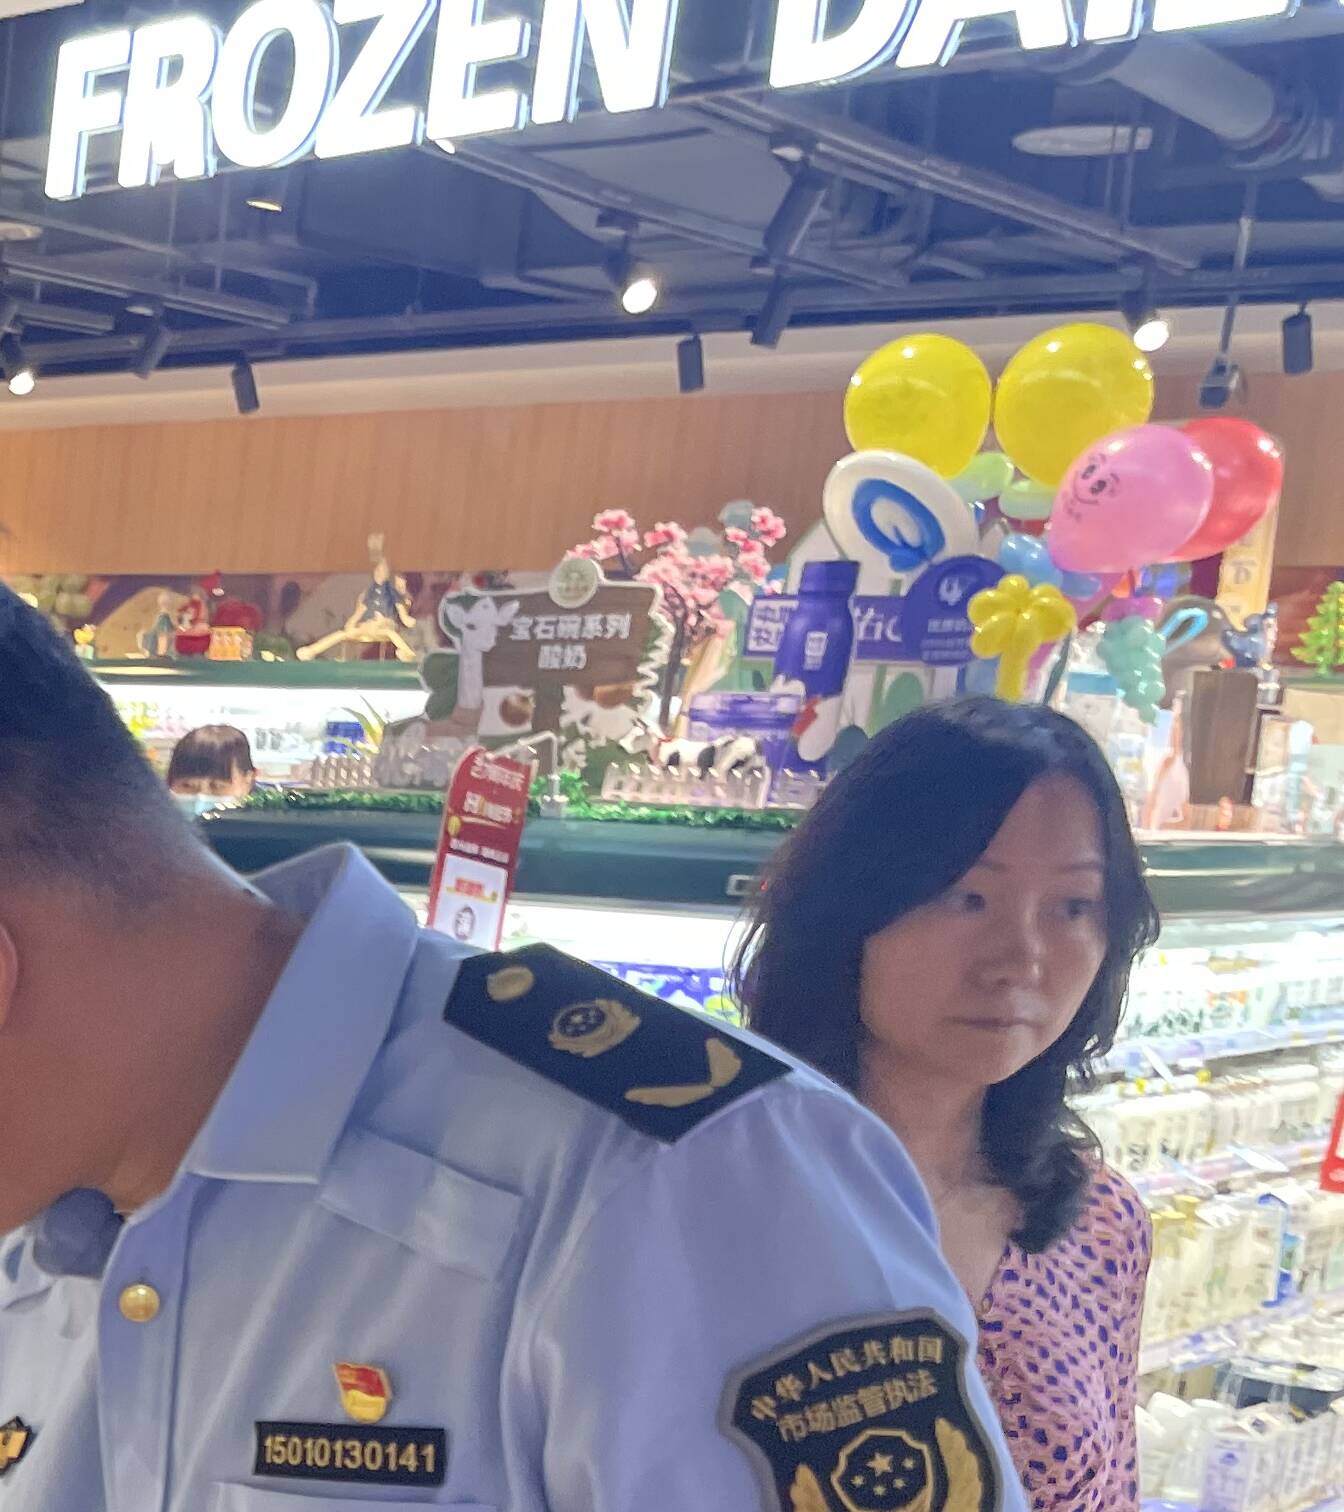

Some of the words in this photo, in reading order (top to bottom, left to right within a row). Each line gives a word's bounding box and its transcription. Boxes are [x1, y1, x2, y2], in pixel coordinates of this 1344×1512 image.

[44, 0, 684, 200] FROZEN
[537, 644, 588, 672] 酸奶
[750, 1334, 944, 1422] 中华人民共和国
[775, 1367, 940, 1443] 市场监管执法
[264, 1434, 436, 1473] 15010130141
